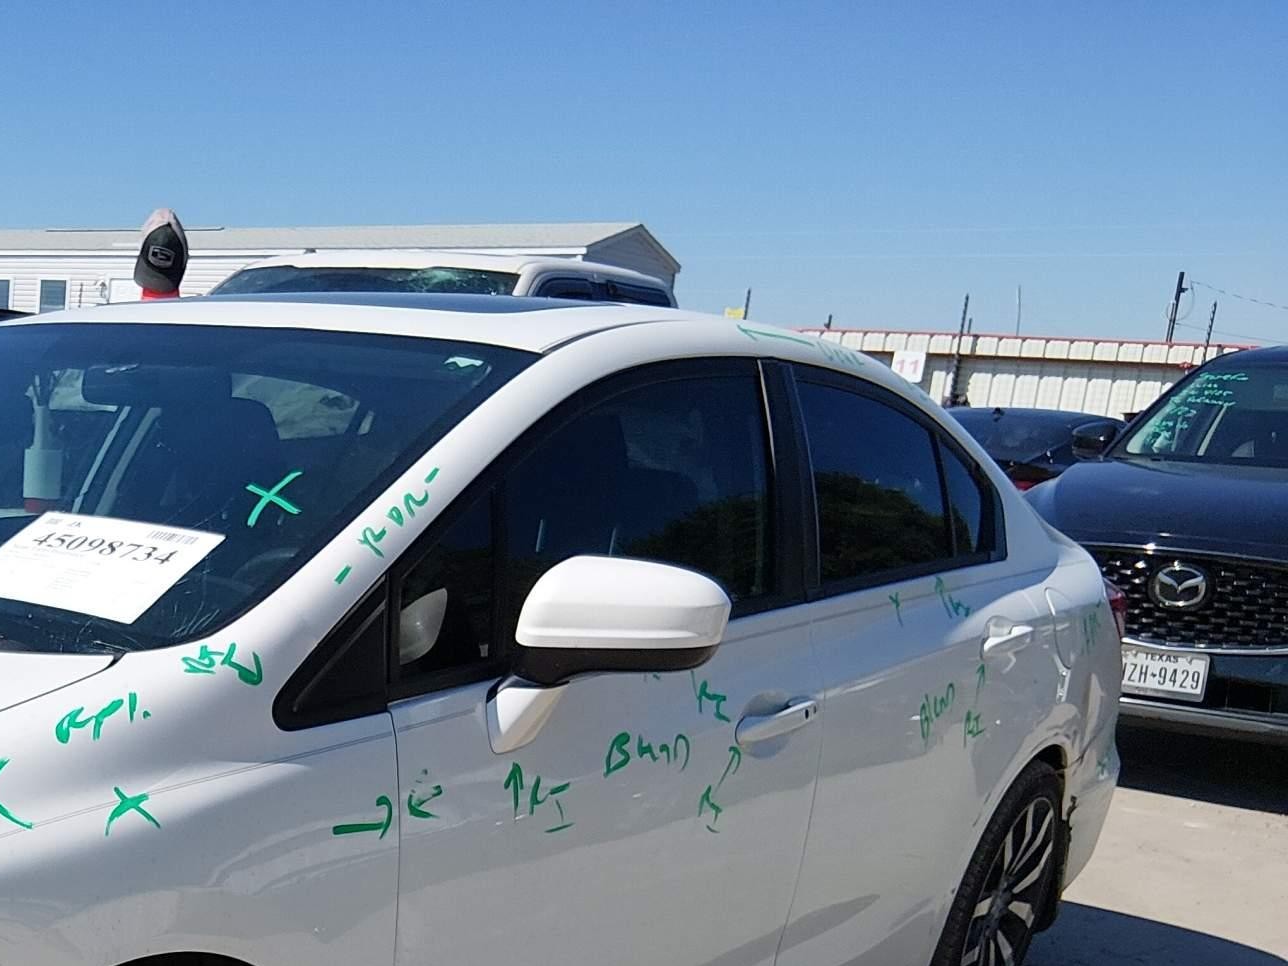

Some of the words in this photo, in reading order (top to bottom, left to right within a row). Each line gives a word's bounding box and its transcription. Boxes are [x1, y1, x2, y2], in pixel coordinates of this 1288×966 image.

[896, 358, 920, 375] 11
[32, 532, 178, 565] 45098734
[1144, 652, 1179, 664] TEXAS
